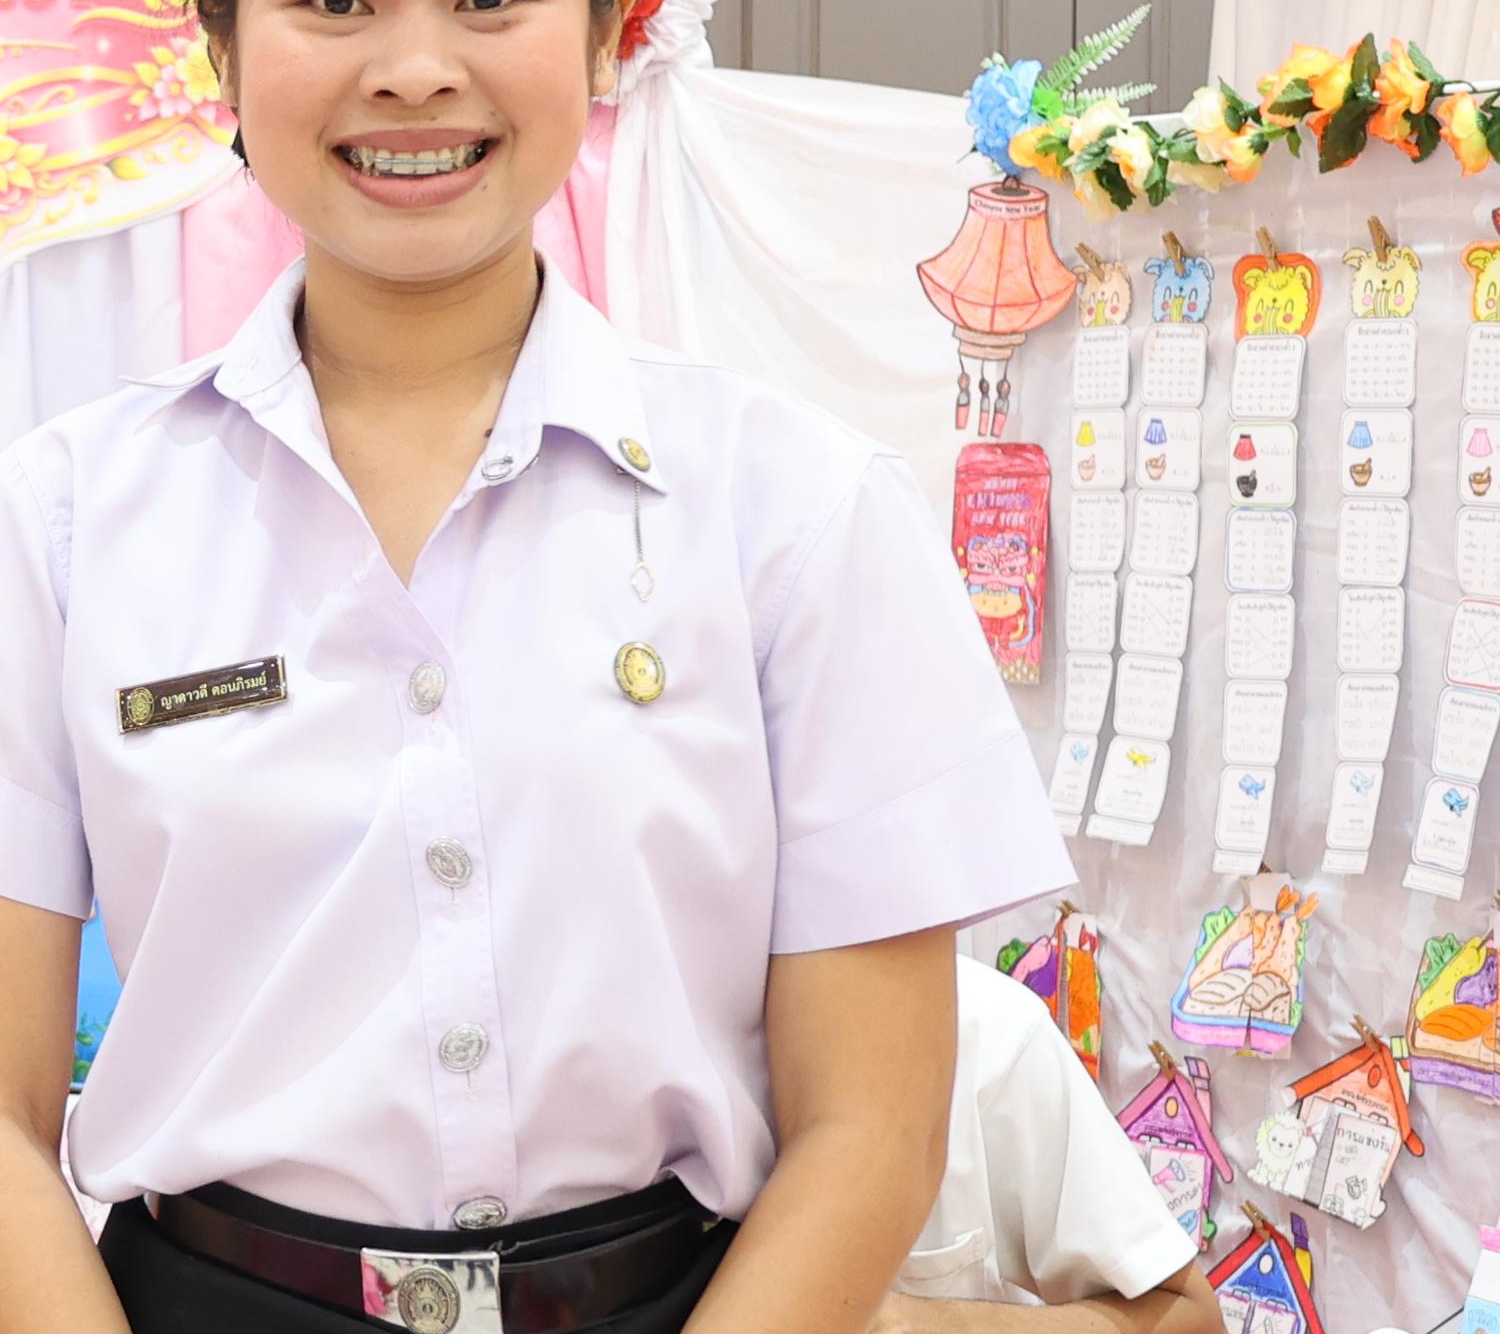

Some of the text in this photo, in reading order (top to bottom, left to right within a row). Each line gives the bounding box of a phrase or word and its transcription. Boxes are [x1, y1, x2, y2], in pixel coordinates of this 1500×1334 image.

[974, 198, 1042, 215] Chinese New Year
